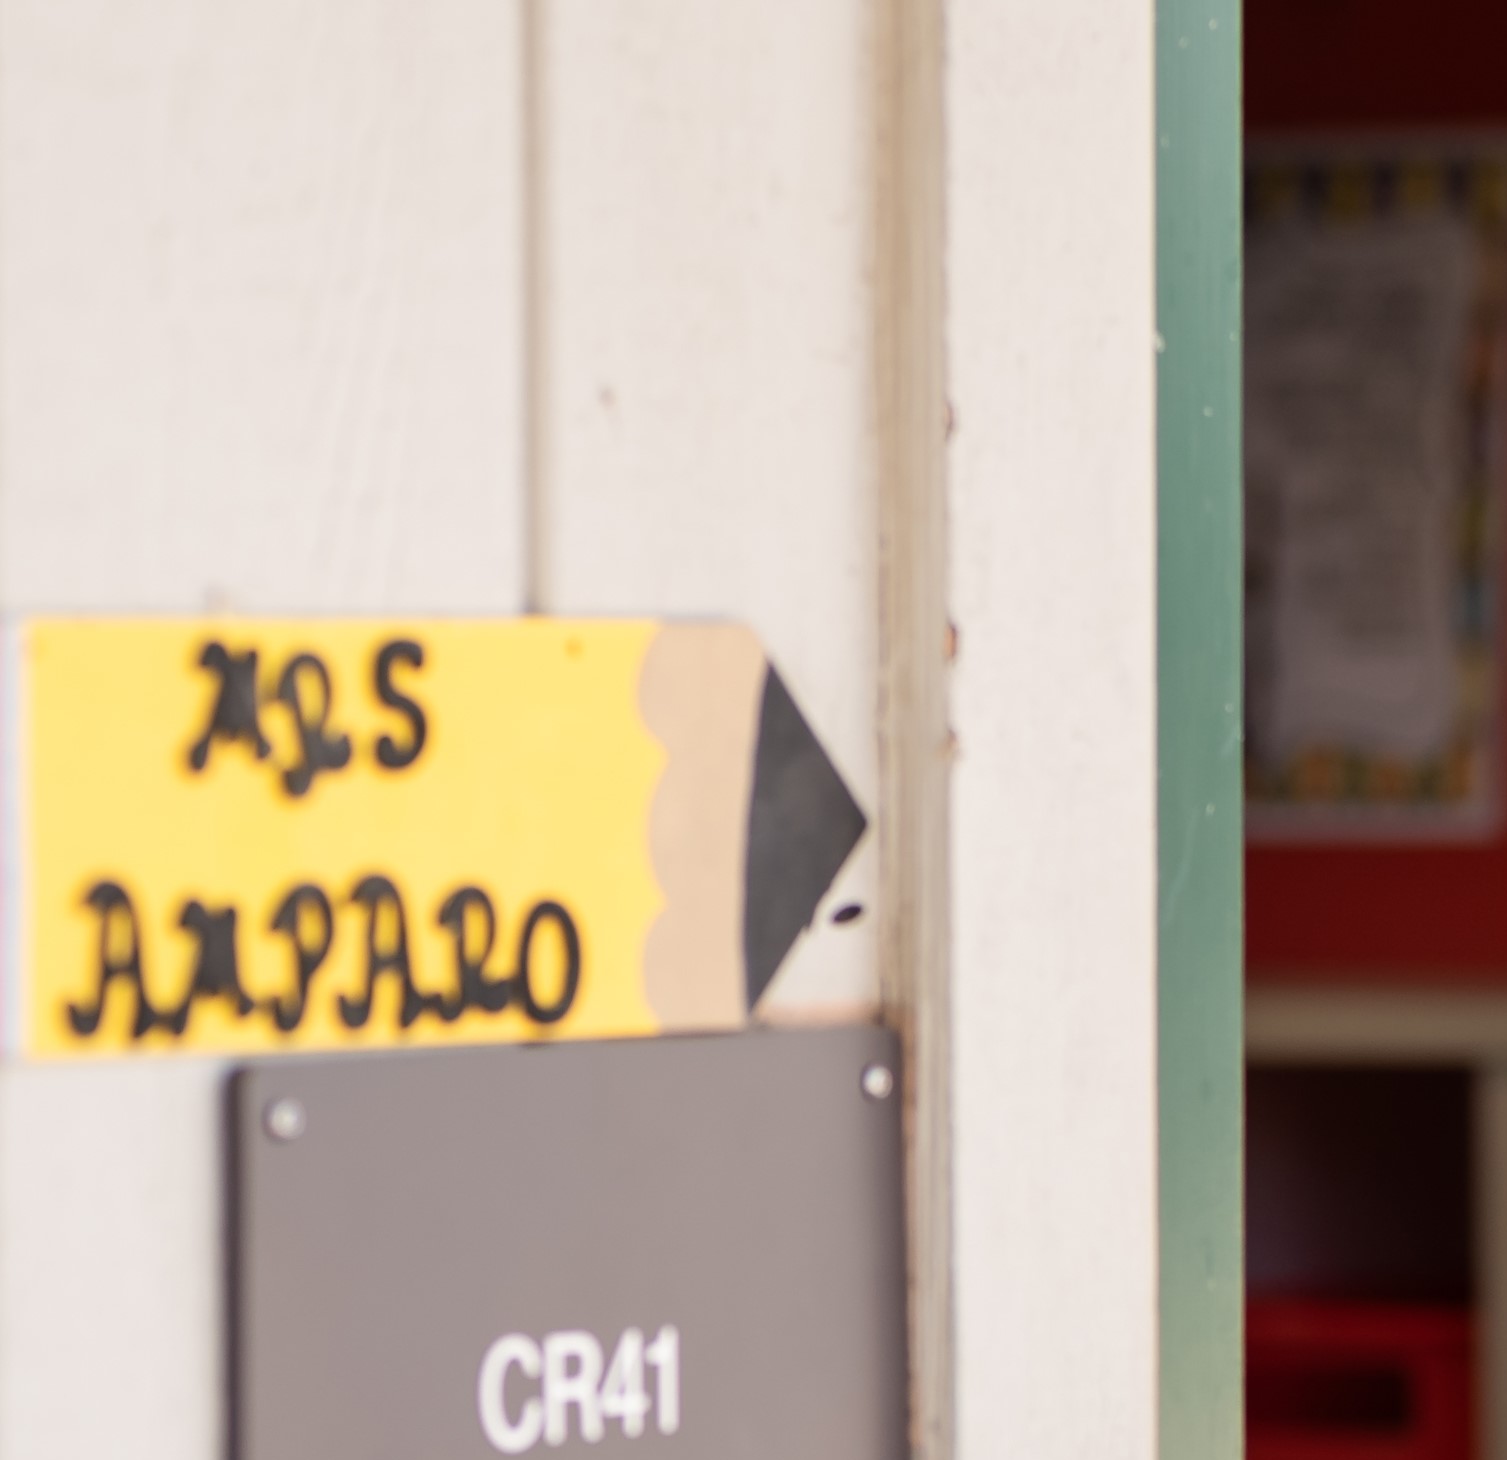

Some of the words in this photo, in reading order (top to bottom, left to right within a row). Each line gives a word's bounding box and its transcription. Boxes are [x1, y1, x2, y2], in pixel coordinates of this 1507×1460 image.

[186, 638, 430, 800] MRS
[66, 874, 584, 1042] AMPARO
[477, 1323, 681, 1454] CR41
